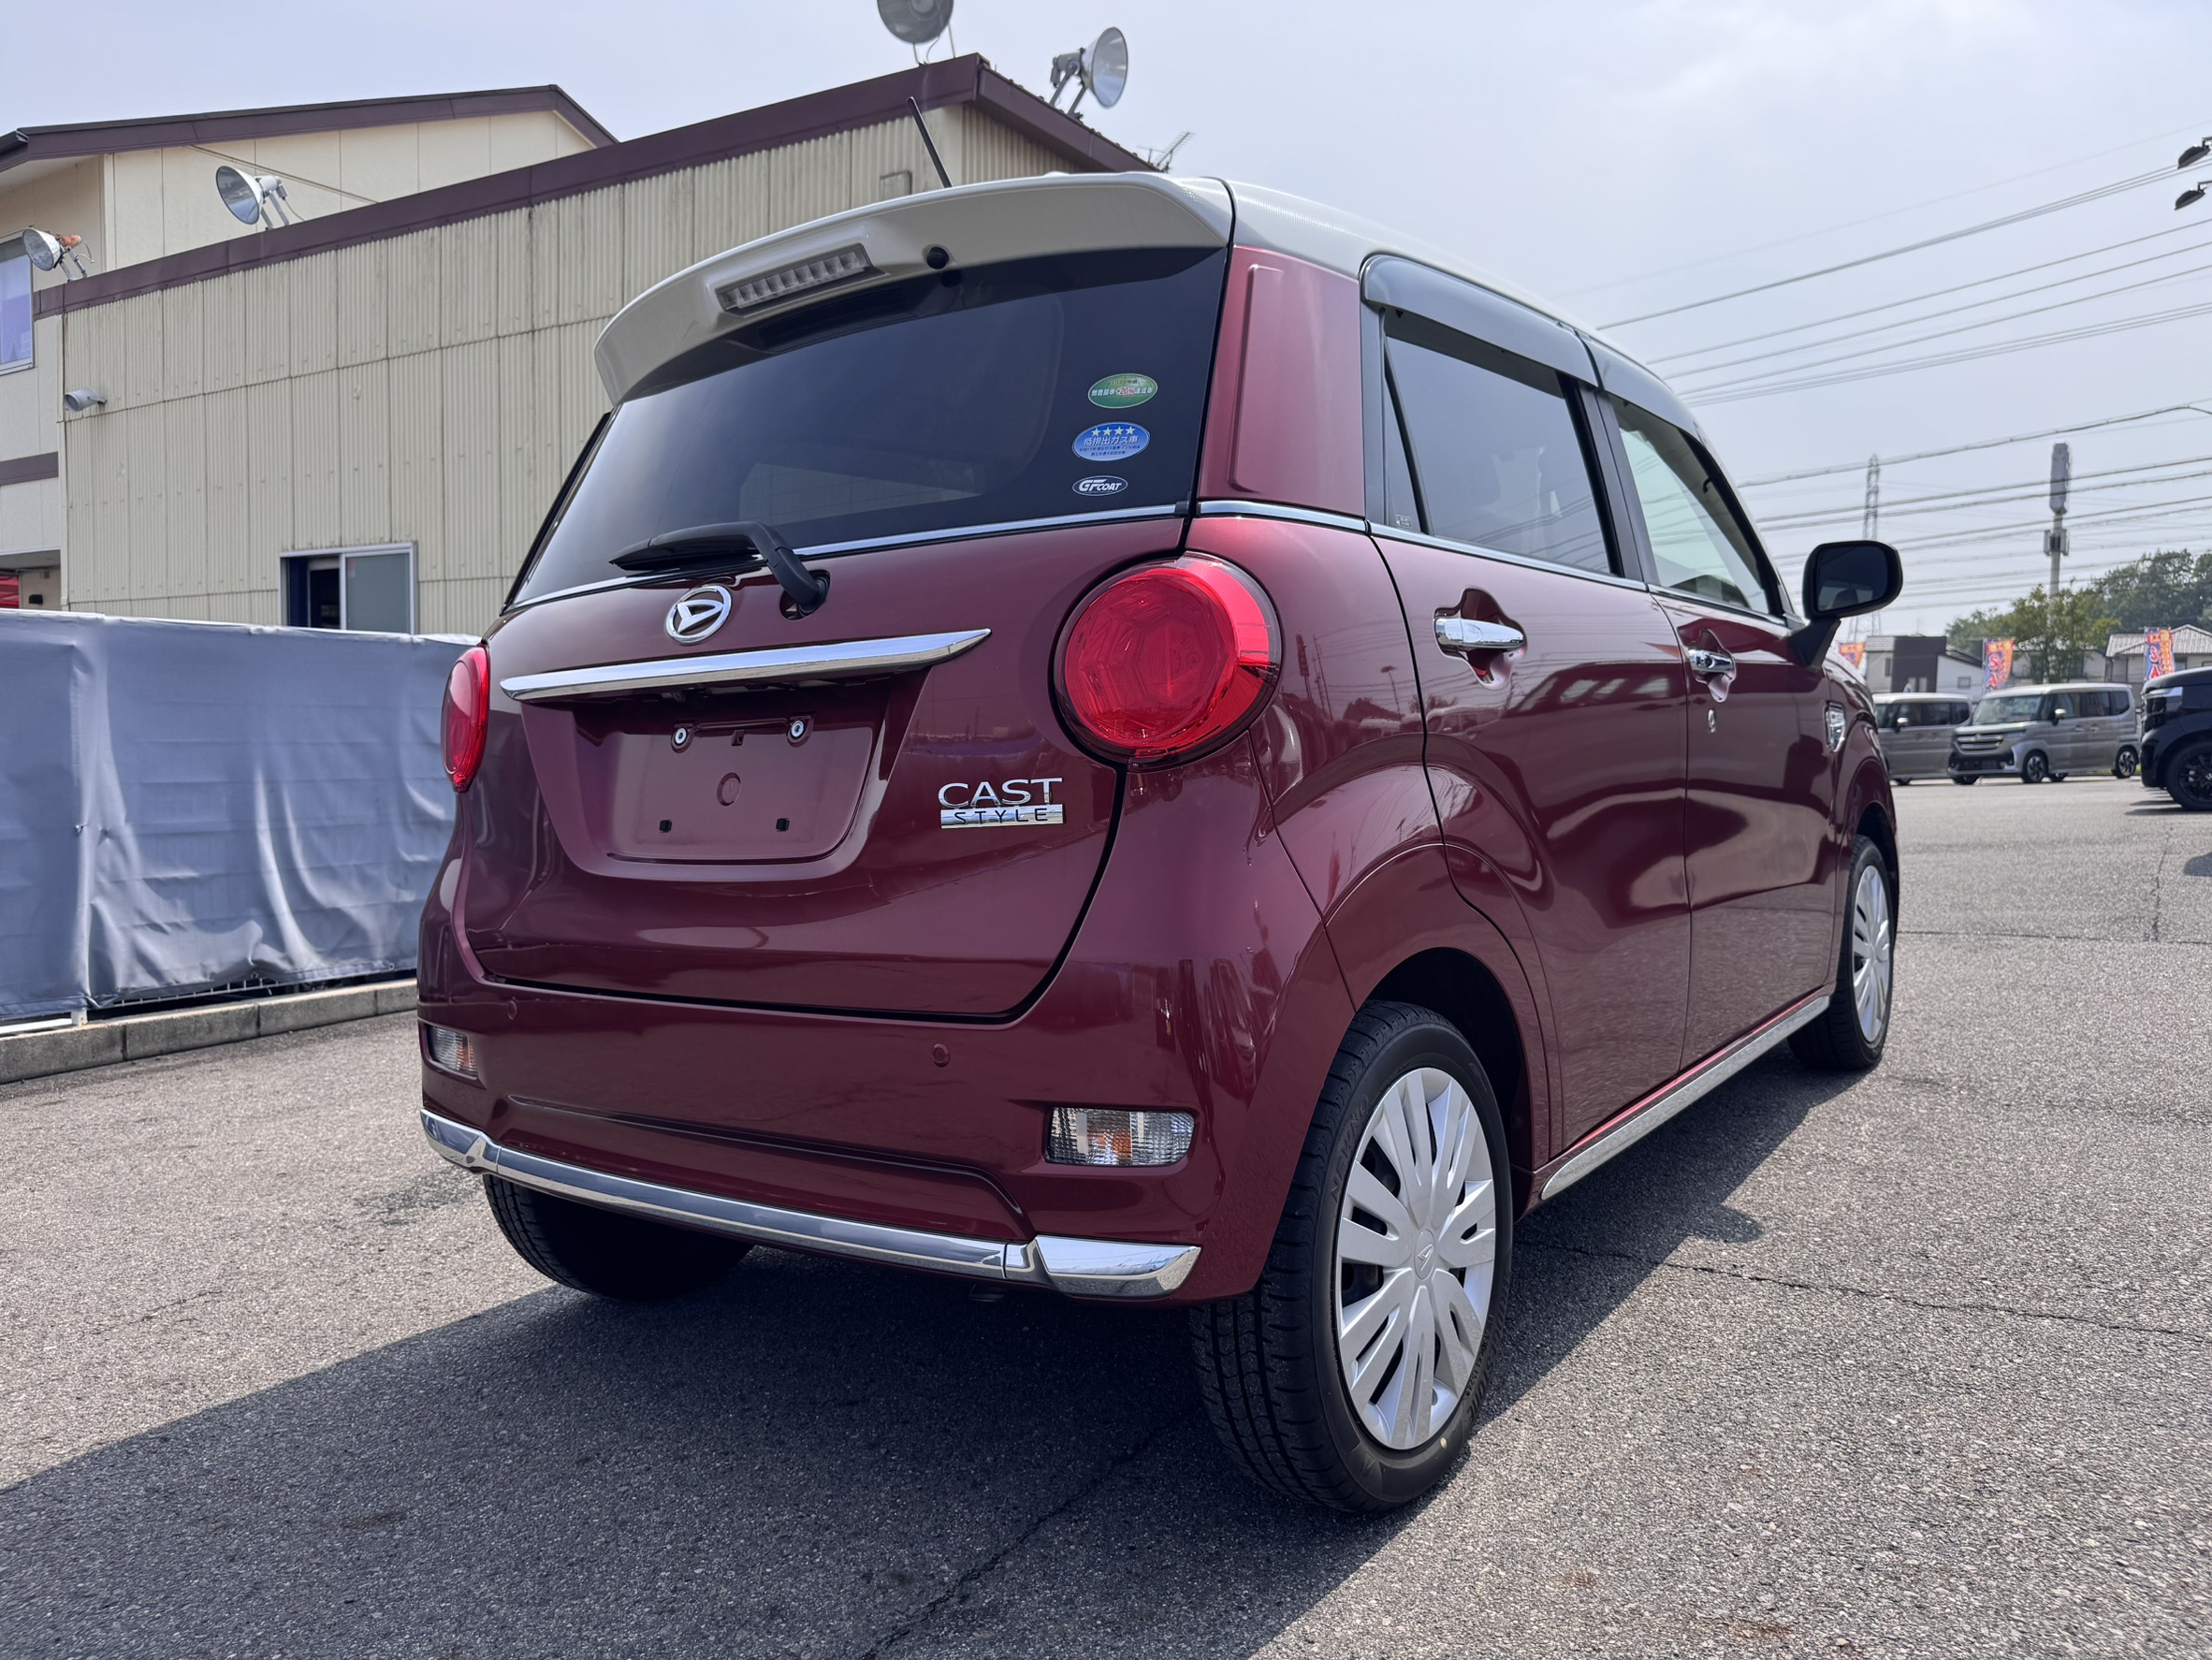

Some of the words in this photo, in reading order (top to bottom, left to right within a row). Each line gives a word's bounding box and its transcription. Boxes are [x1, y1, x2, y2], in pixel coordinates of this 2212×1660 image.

[1084, 436, 1139, 446] 低排出ガス車
[938, 778, 1063, 808] CAST
[953, 808, 1048, 825] STYLE
